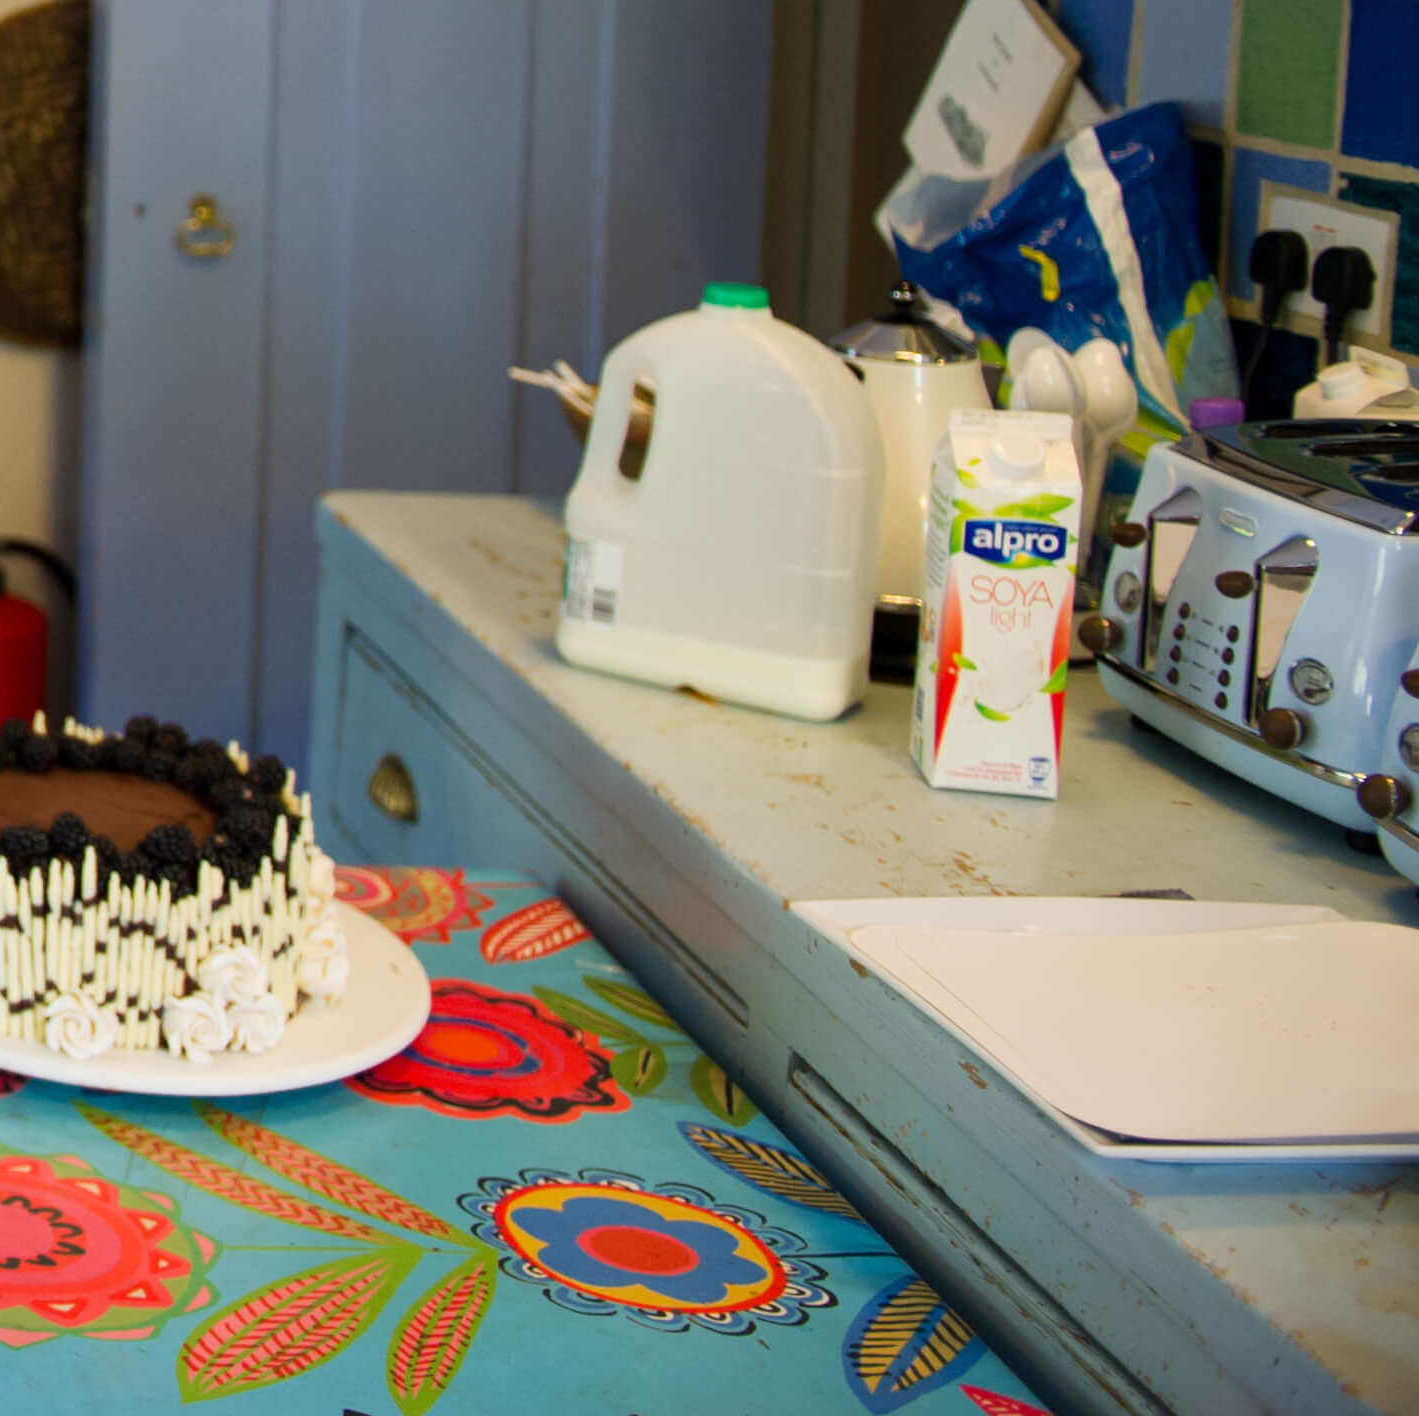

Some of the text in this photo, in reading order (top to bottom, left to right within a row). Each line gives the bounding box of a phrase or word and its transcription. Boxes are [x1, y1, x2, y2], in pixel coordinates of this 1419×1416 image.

[972, 522, 1059, 558] alpro
[970, 574, 1053, 609] SOYA
[990, 605, 1031, 633] light
